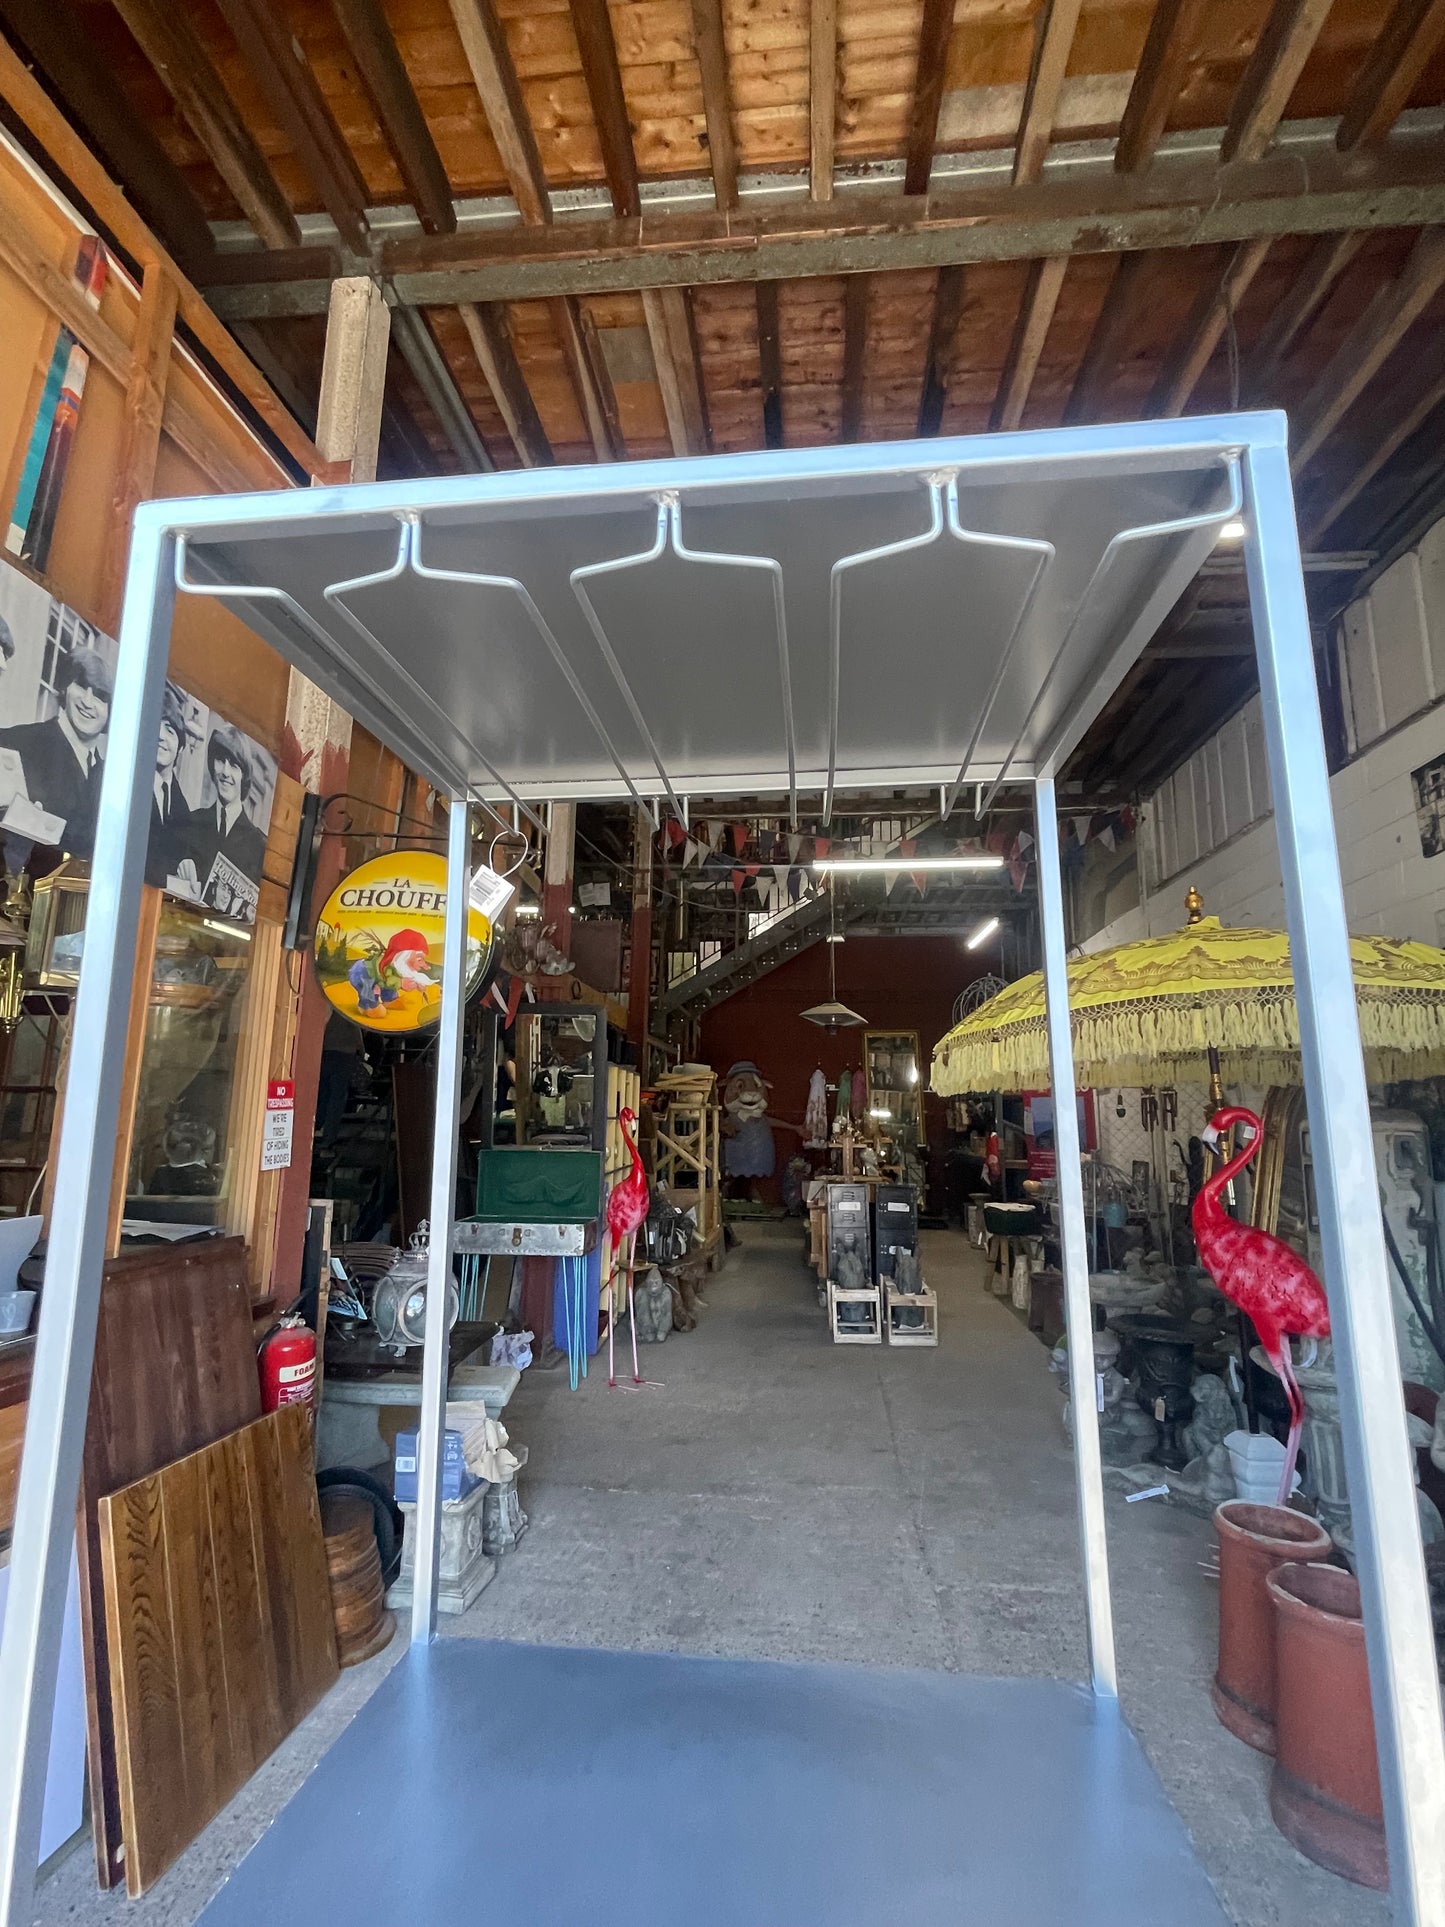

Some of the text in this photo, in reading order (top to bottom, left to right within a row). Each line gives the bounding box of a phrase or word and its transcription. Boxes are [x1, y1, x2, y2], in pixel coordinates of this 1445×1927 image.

[214, 861, 246, 897] Rolling
[393, 878, 411, 888] LA
[340, 889, 447, 911] CHOUFF
[277, 1086, 286, 1096] NO
[272, 1127, 285, 1137] TIRED
[266, 1139, 289, 1151] OF HIDING
[264, 1153, 290, 1165] THE BODIES
